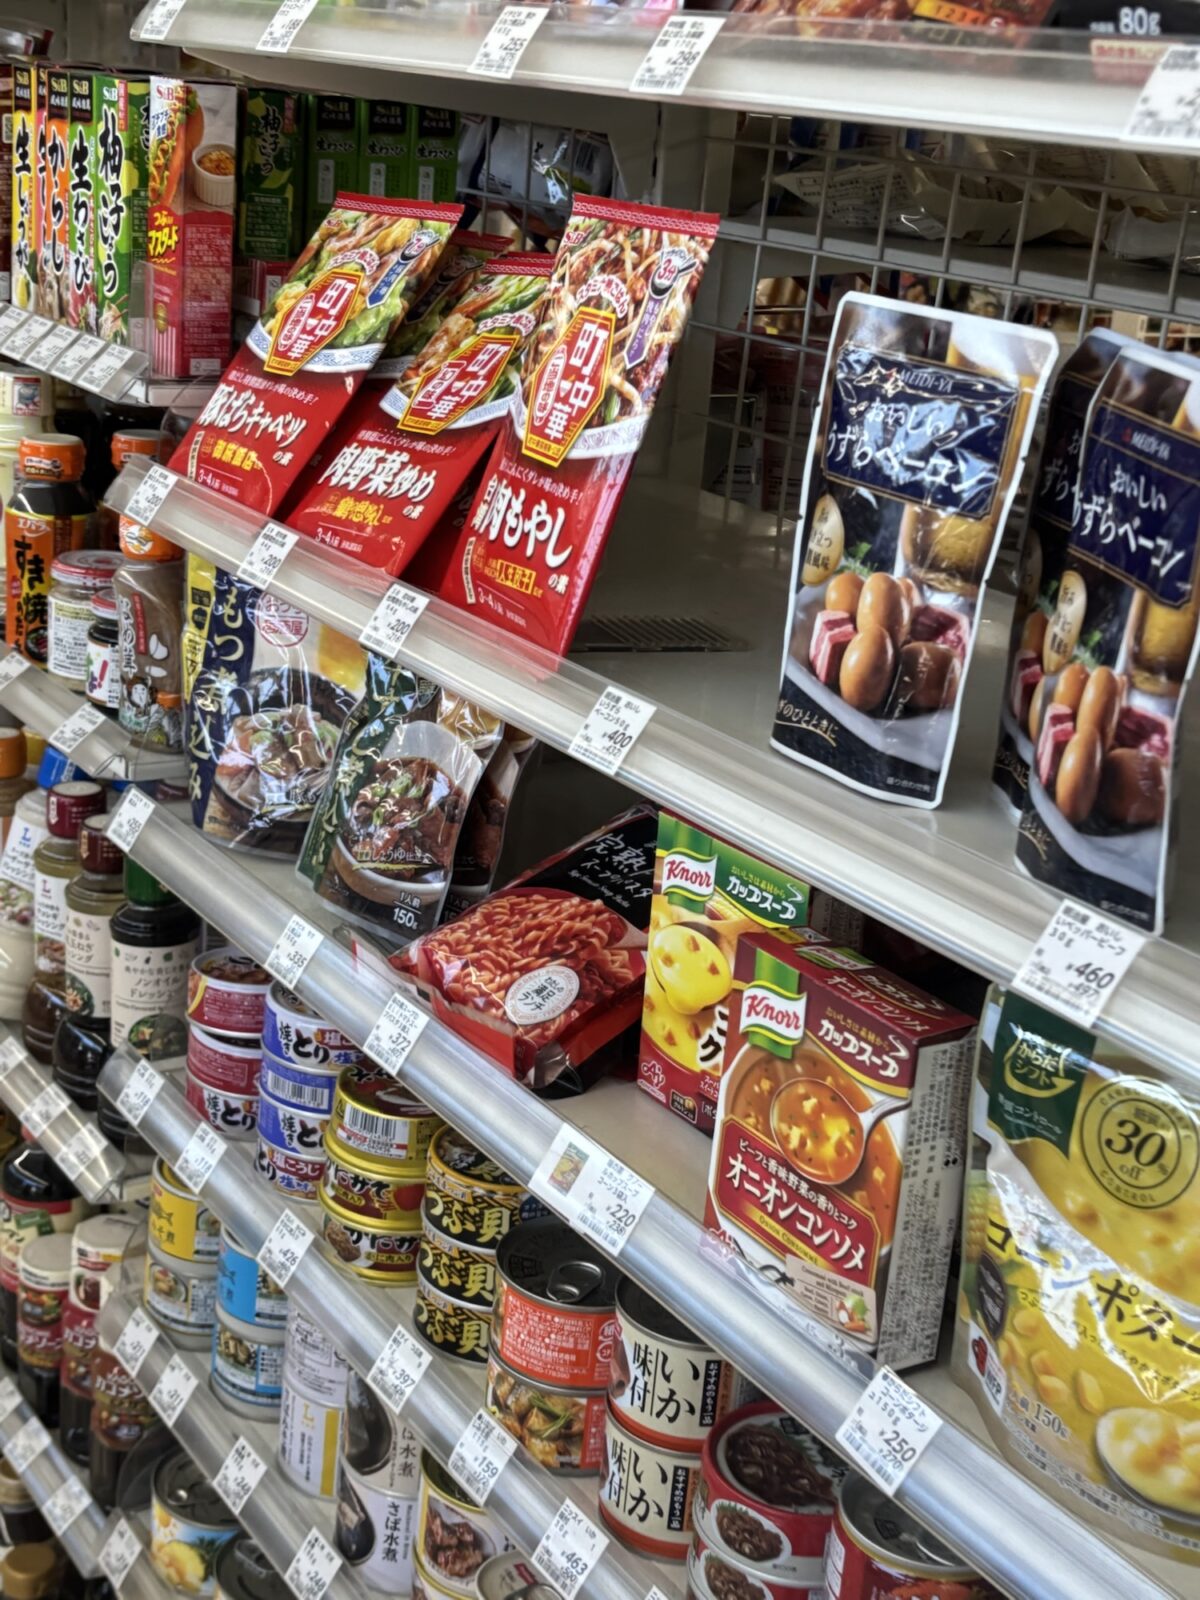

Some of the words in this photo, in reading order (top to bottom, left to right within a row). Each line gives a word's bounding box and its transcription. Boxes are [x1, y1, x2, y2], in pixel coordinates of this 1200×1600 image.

[1119, 7, 1161, 36] 80g
[70, 126, 92, 293] 生わさび
[288, 278, 357, 360] 町中華
[427, 343, 511, 419] 町中華
[543, 321, 610, 441] 町中華
[272, 450, 294, 467] の素
[317, 442, 437, 502] 肉野菜炒め
[402, 504, 424, 519] の素
[547, 573, 570, 594] の素
[386, 618, 411, 636] ¥200
[602, 728, 633, 749] ¥400
[666, 857, 713, 890] Knorr
[725, 874, 798, 921] カップスープ
[392, 907, 419, 931] 150g
[286, 950, 309, 969] ¥335
[1065, 962, 1115, 989] ¥460
[744, 994, 802, 1032] Knorr
[293, 1027, 331, 1064] とり
[387, 1034, 412, 1052] ¥372
[817, 1018, 900, 1079] カップスープ
[1013, 1060, 1052, 1088] シフト
[220, 1100, 256, 1132] とり
[272, 1151, 321, 1177] 塩こうじ
[1119, 1164, 1146, 1181] off
[604, 1202, 638, 1229] ¥220
[724, 1152, 867, 1271] オニオンコンソメ
[278, 1248, 299, 1267] ¥426
[391, 1368, 416, 1388] ¥397
[630, 1339, 652, 1414] 味付
[655, 1348, 701, 1427] いか
[876, 1428, 918, 1464] ¥250
[473, 1455, 499, 1479] ¥159
[606, 1439, 627, 1511] 味付
[627, 1447, 670, 1525] いか
[381, 1501, 402, 1563] さば水煮
[560, 1549, 589, 1576] ¥463
